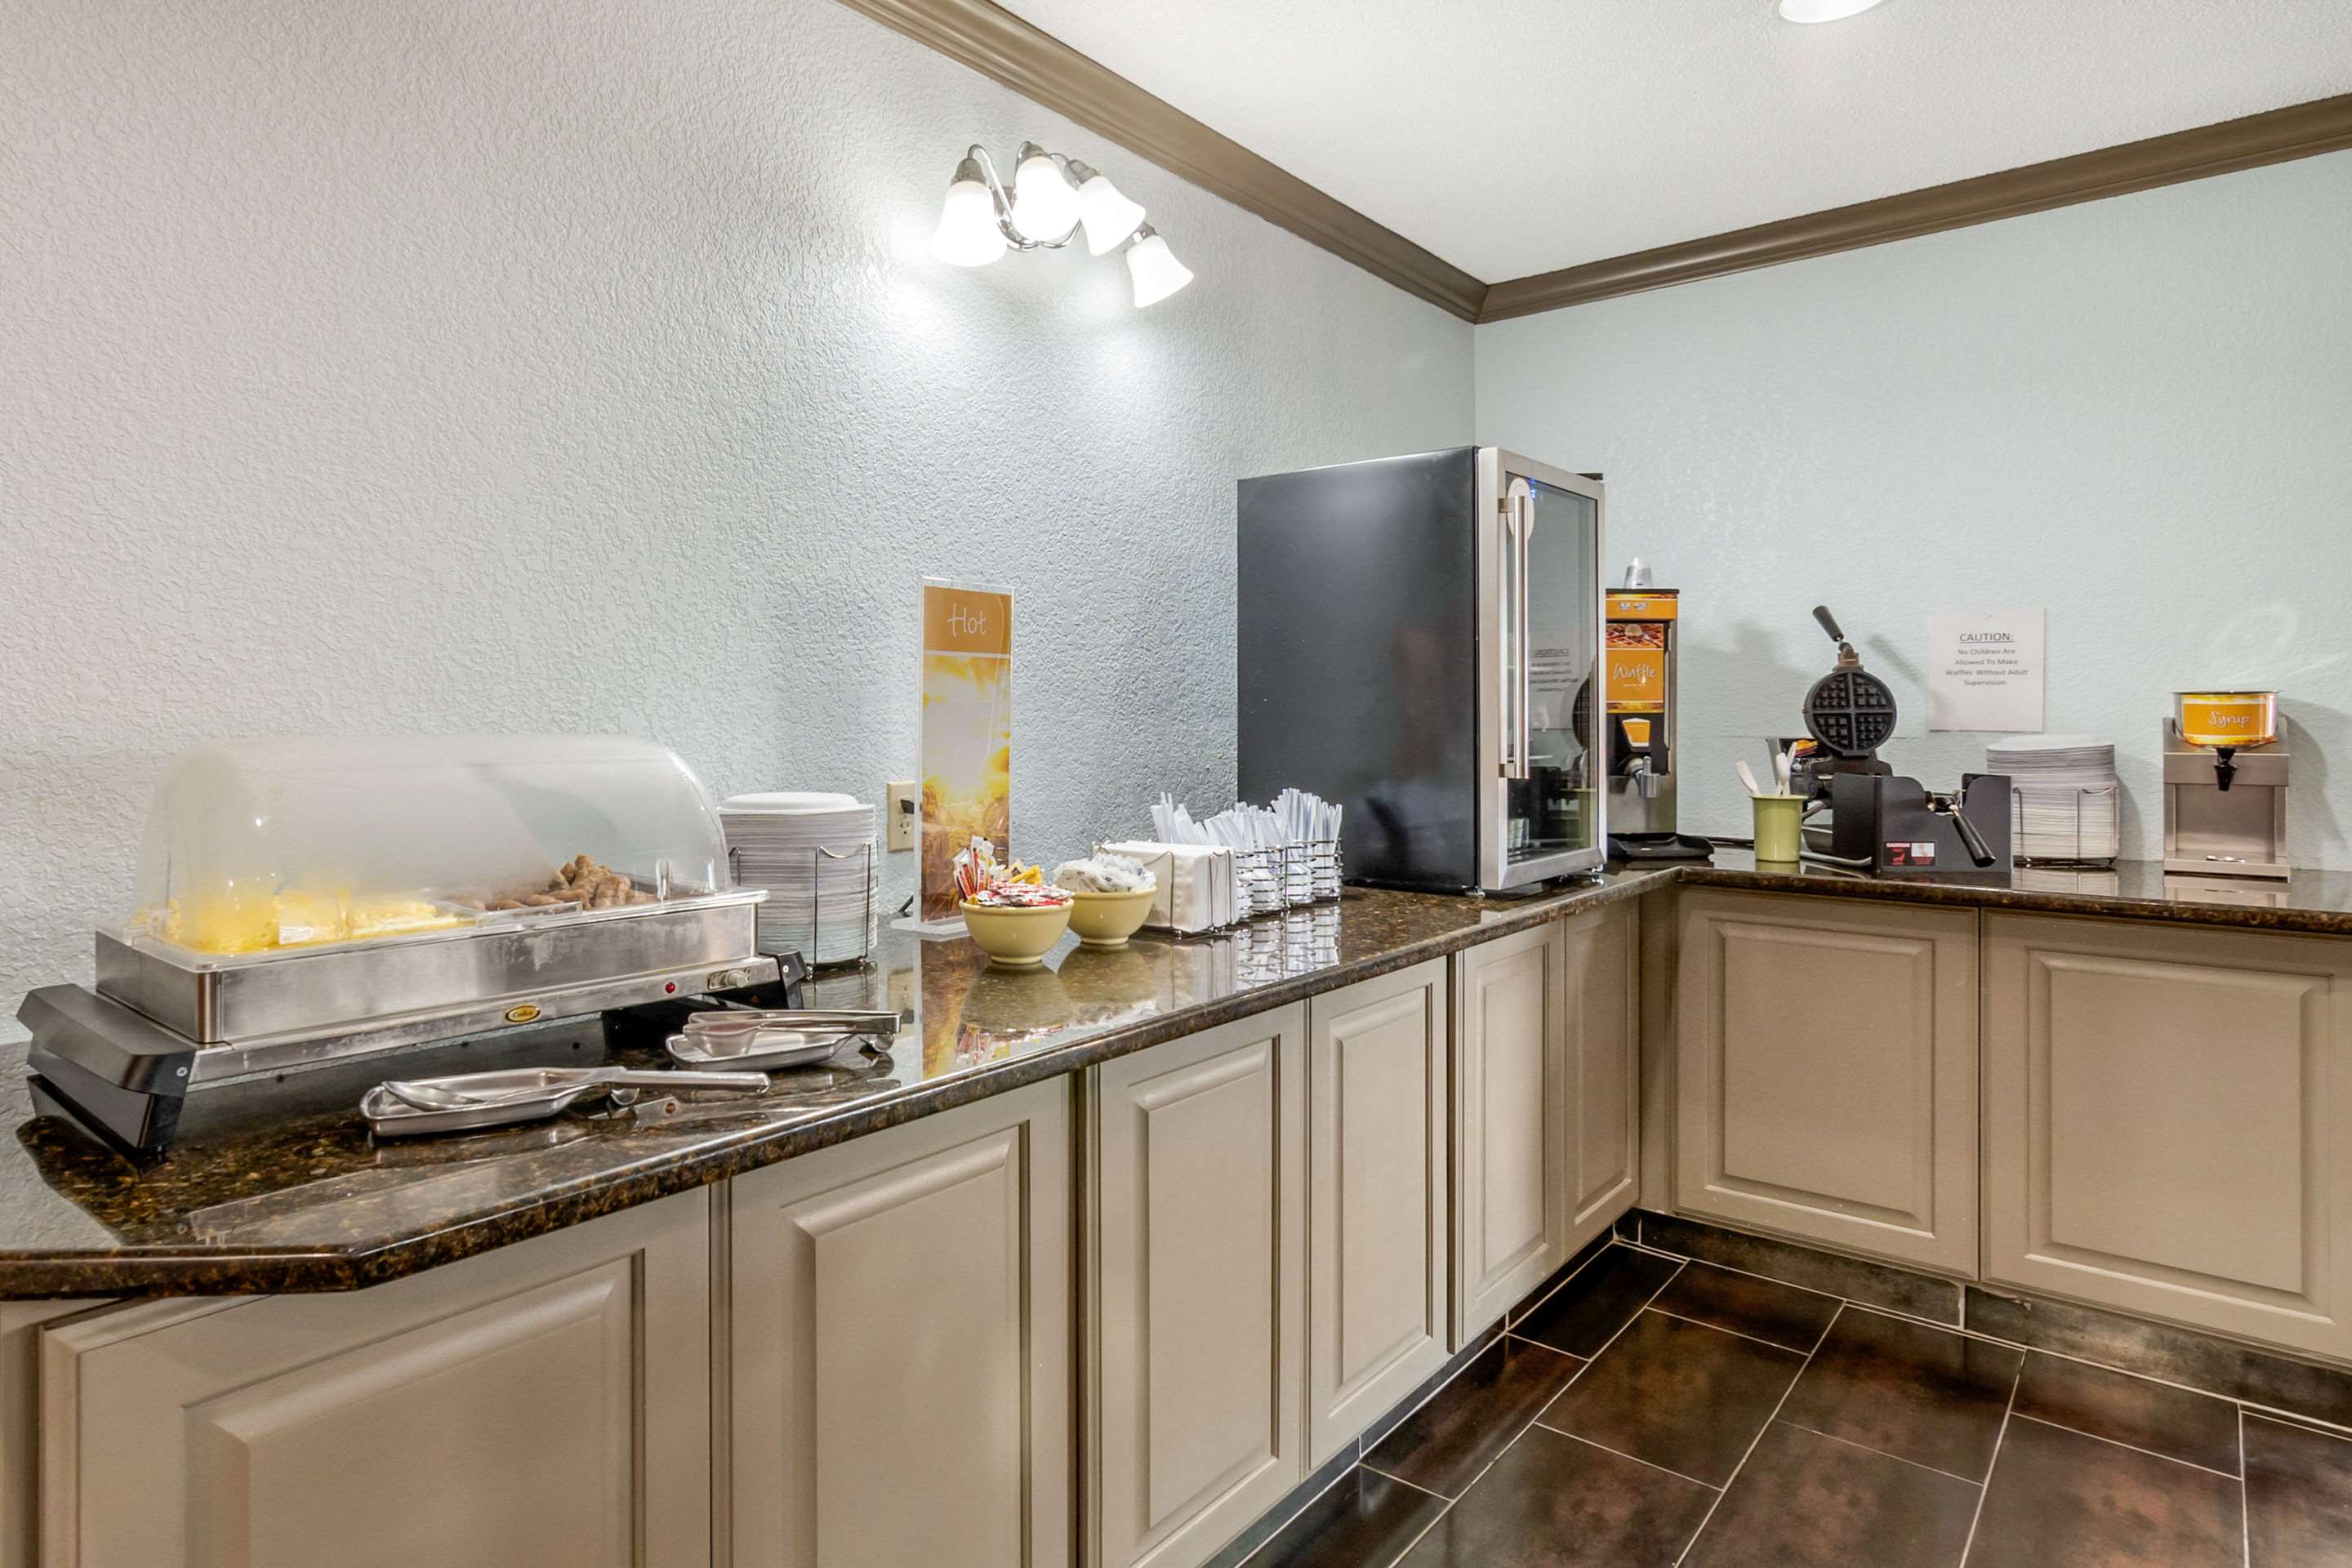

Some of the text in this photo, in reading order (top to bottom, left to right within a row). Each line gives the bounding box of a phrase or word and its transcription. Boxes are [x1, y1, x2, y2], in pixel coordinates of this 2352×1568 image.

[947, 602, 987, 637] Hot
[1959, 633, 2014, 642] CAUTION:
[1614, 662, 1657, 684] Waffle
[2207, 710, 2252, 731] Syrup
